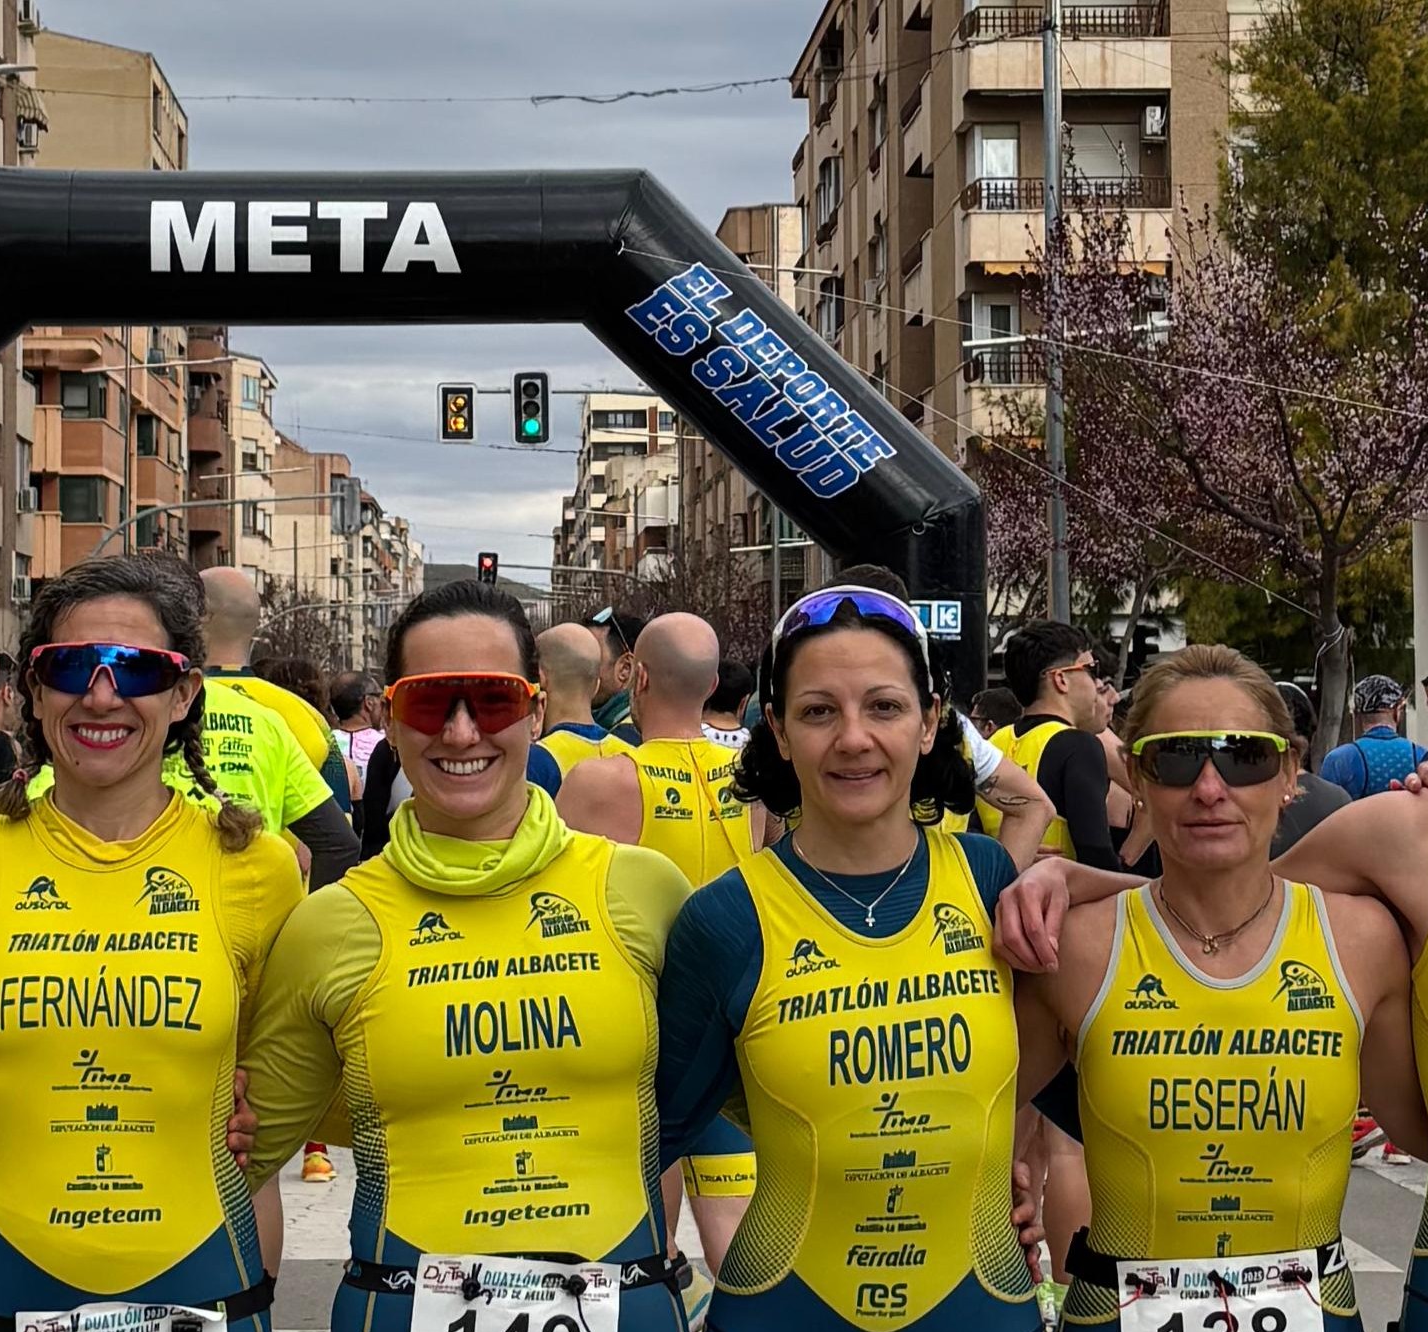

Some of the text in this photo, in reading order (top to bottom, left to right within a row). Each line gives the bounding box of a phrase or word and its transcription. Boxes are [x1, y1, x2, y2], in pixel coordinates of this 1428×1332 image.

[149, 200, 461, 273] META
[667, 262, 897, 472] EL DEPORTE
[624, 284, 860, 498] ES SALUD
[204, 712, 253, 734] LBACETE
[8, 929, 198, 953] TRIATLÓN ALBACETE
[408, 952, 600, 987] TRIATLÓN ALBACETE
[0, 966, 202, 1031] FERNÁNDEZ
[777, 969, 1000, 1024] TRIATLÓN ALBACETE
[445, 994, 582, 1058] MOLINA
[1111, 1024, 1343, 1057] TRIATLÓN ALBACETE
[829, 1012, 973, 1087] ROMERO
[1149, 1067, 1306, 1132] BESERÁN
[49, 1207, 162, 1229] Ingeteam
[464, 1202, 590, 1227] Ingeteam
[857, 1283, 908, 1308] res
[84, 1306, 143, 1332] DUATLÓN
